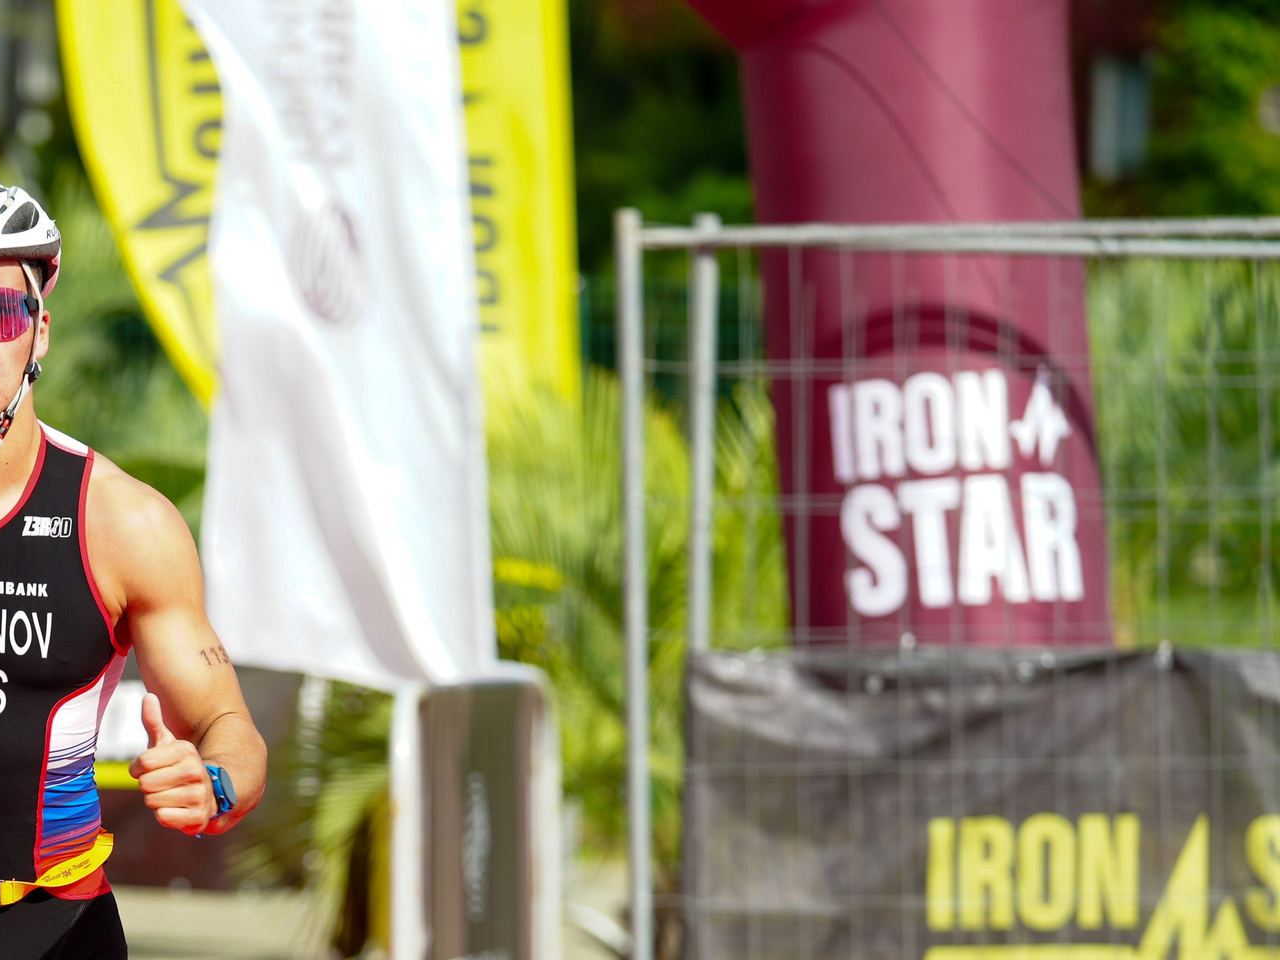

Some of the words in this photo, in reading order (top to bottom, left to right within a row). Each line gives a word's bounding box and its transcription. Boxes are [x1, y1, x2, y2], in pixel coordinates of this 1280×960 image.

[828, 368, 1010, 484] IRON
[840, 472, 1084, 617] STAR
[926, 812, 1140, 931] IRON
